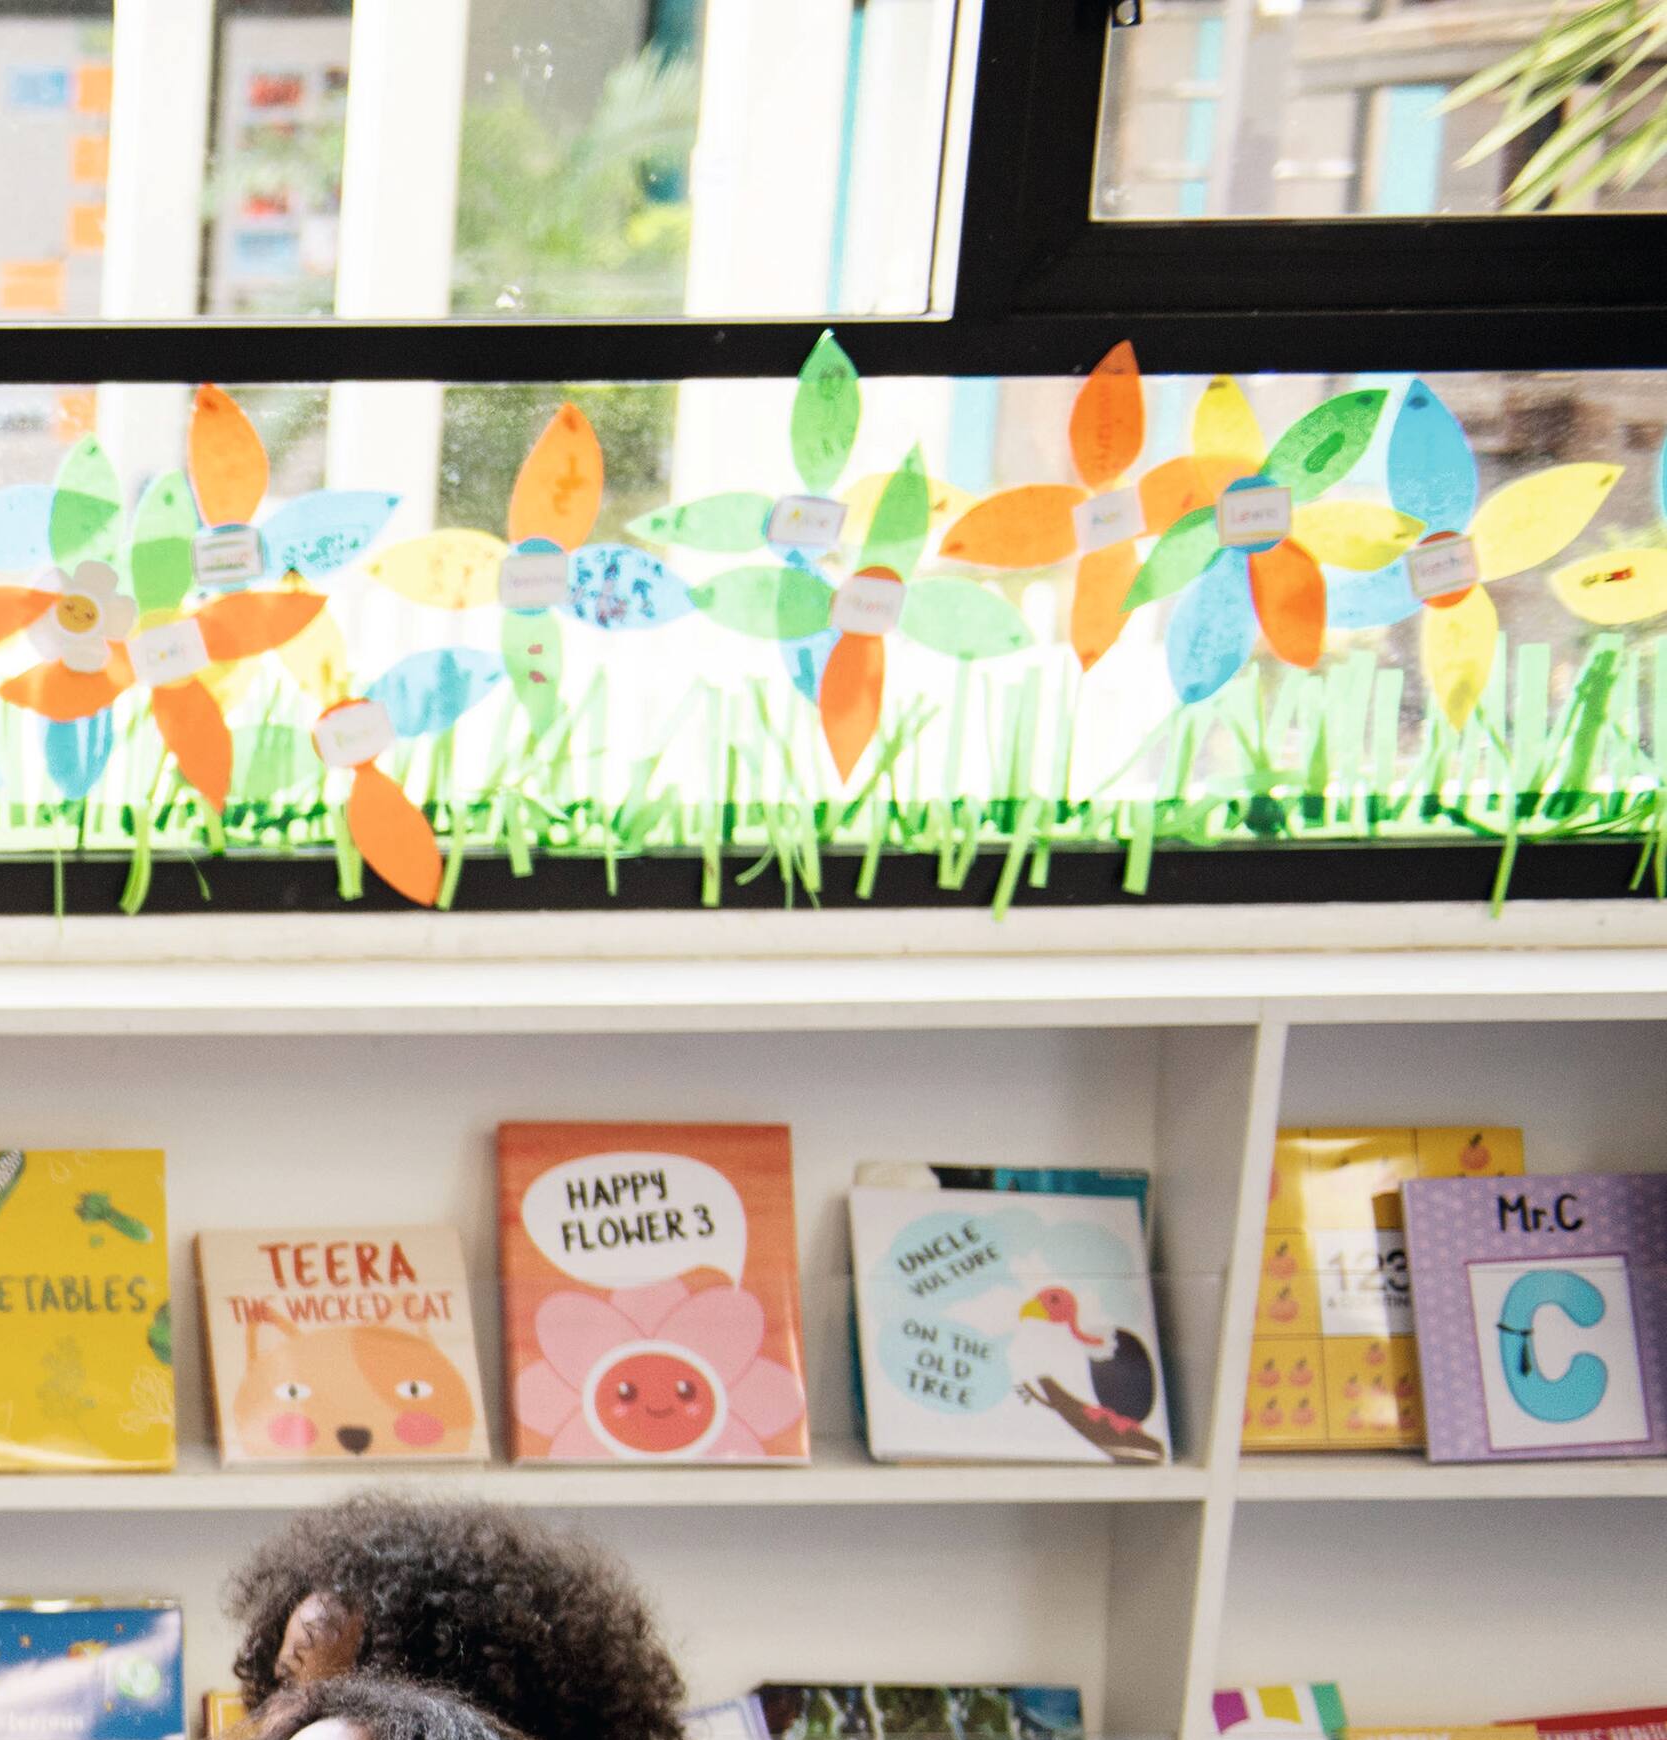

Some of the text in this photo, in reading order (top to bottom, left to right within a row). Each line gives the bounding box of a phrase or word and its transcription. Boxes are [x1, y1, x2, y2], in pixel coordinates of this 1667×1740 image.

[567, 1168, 668, 1211] HAPPY
[561, 1204, 716, 1253] FLOWER 3
[897, 1220, 981, 1275] UNCLE
[259, 1240, 417, 1289] TEERA
[909, 1244, 1002, 1299] VULTURE
[229, 1291, 452, 1323] THE WICKED CAT
[901, 1317, 992, 1361] ON THE
[1499, 1269, 1607, 1424] C
[906, 1369, 975, 1405] TREE
[916, 1349, 972, 1381] OLD
